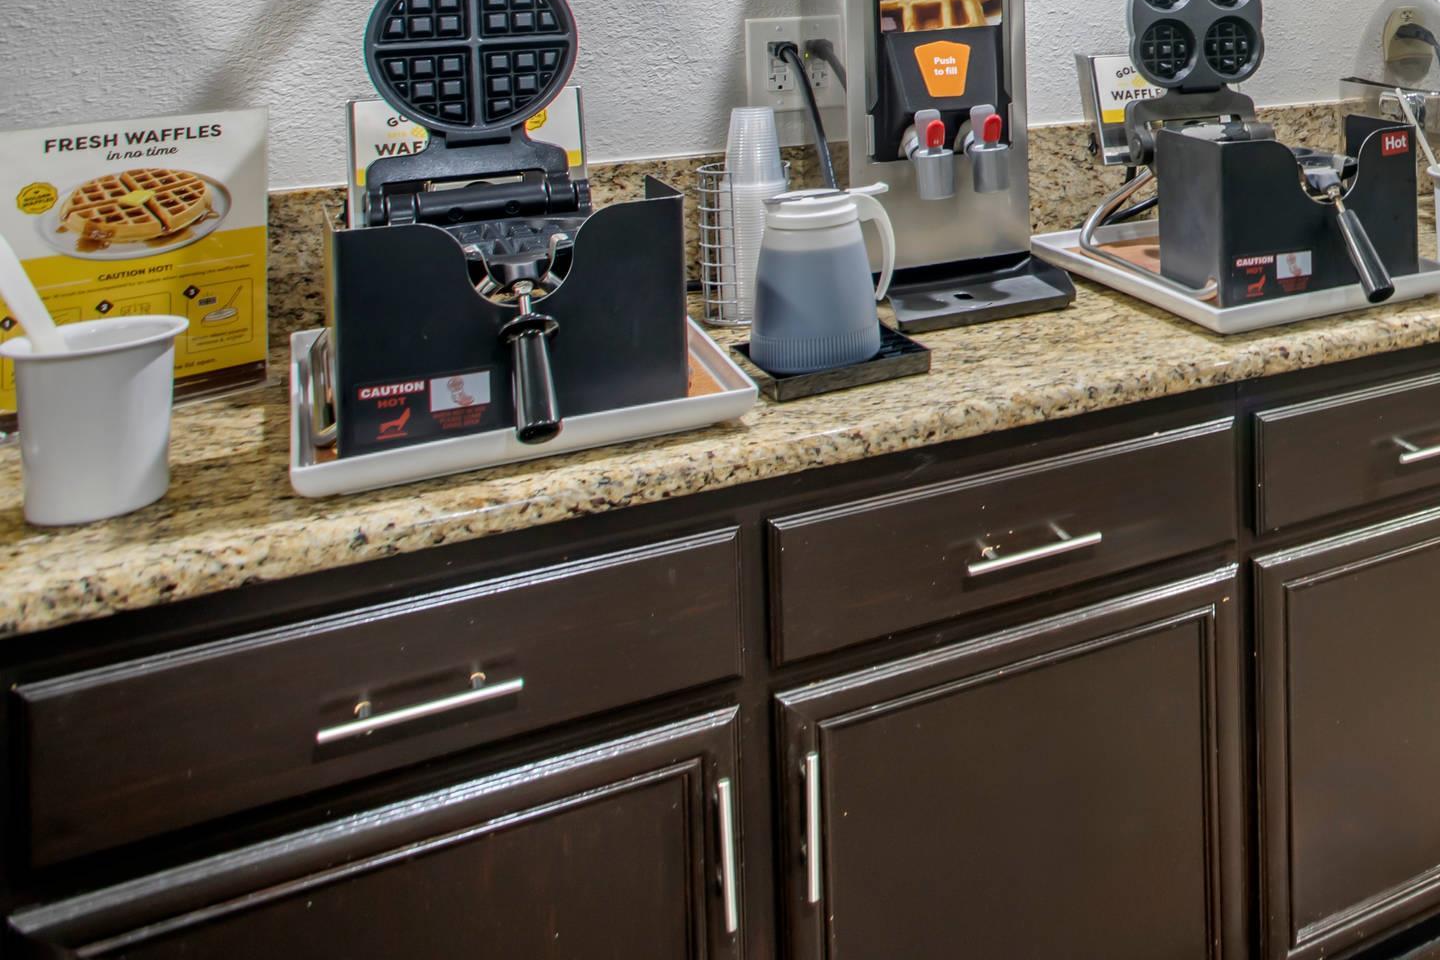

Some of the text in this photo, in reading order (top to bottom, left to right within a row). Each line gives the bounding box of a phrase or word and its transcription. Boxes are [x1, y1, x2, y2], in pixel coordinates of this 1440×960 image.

[933, 56, 956, 65] Push
[934, 66, 958, 76] to fill
[1115, 66, 1137, 79] GOL
[1111, 88, 1164, 101] WAFFLE
[44, 124, 222, 154] FRESH WAFFLES
[1385, 134, 1407, 151] Hot
[106, 146, 178, 161] in no time
[1236, 255, 1274, 267] CAUTION
[98, 268, 146, 282] CAUTION
[361, 380, 425, 399] CAUTION
[377, 396, 406, 409] HOT
